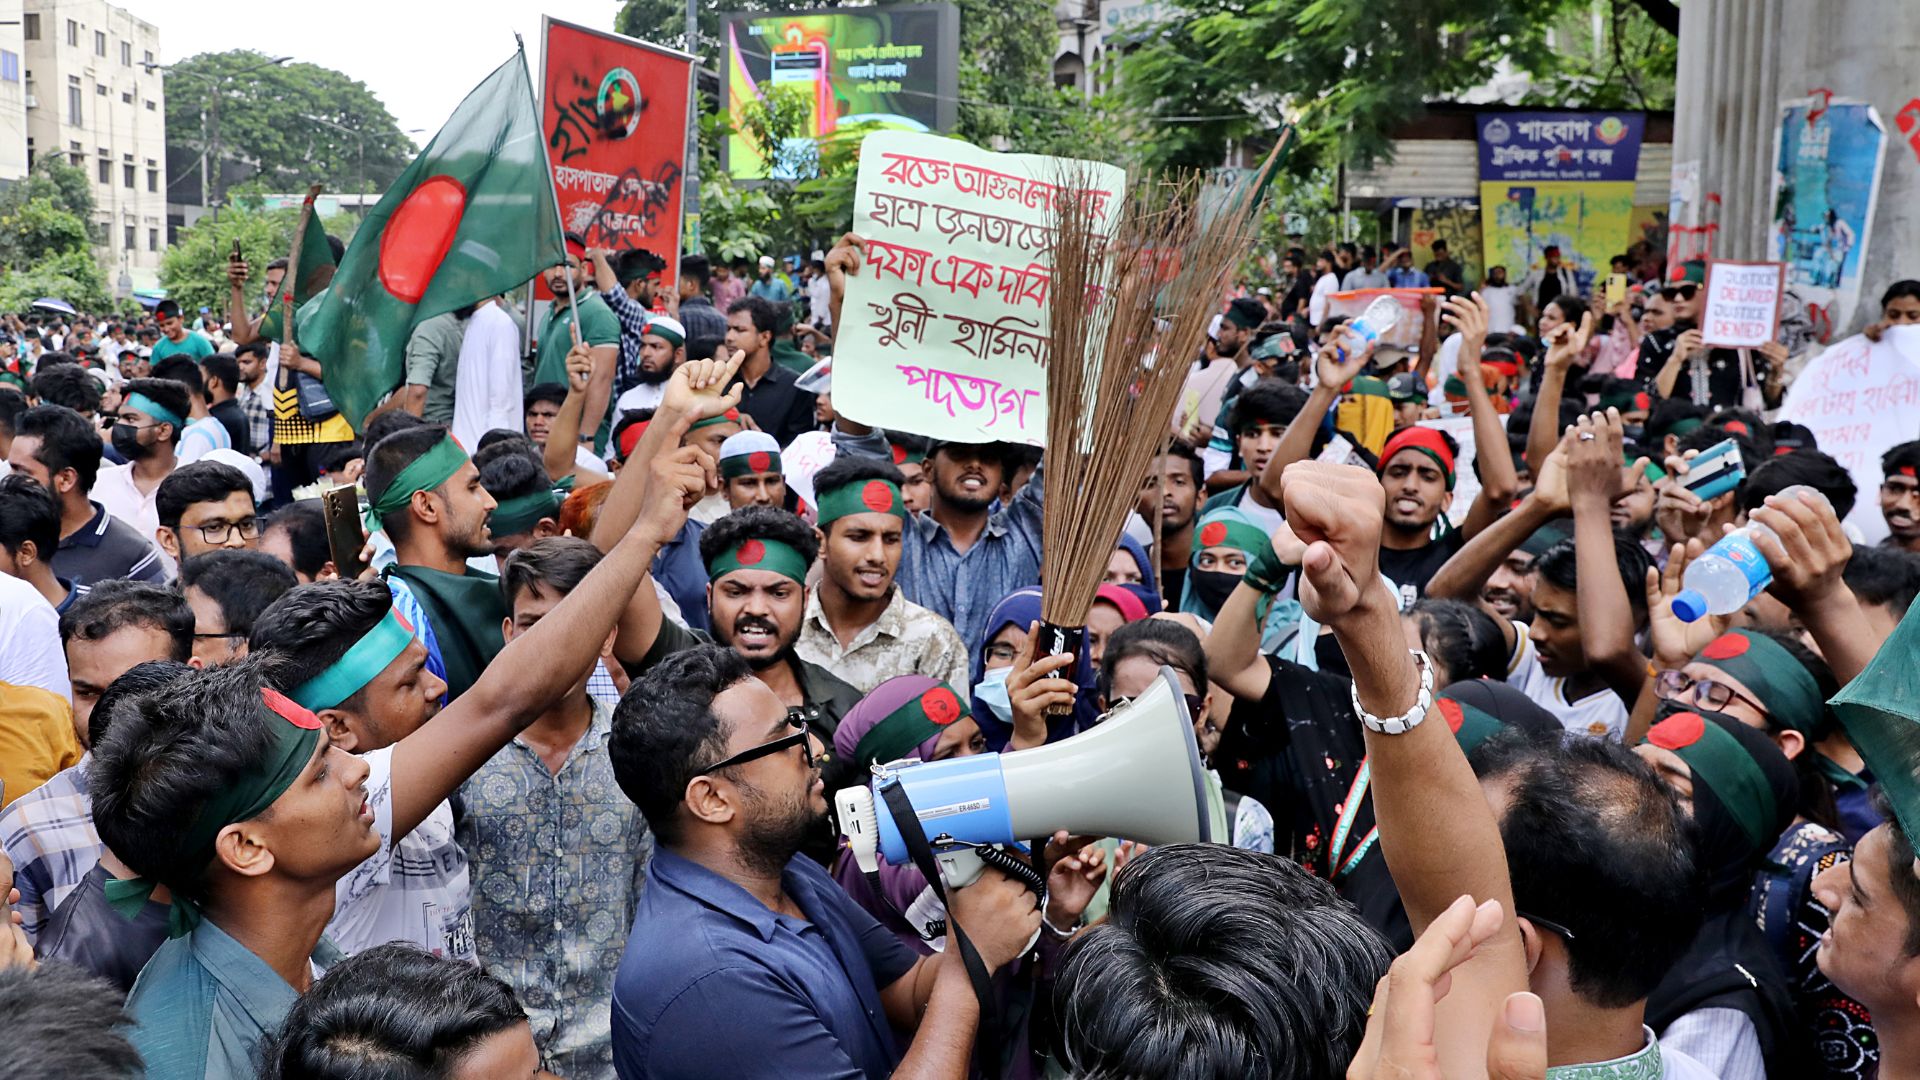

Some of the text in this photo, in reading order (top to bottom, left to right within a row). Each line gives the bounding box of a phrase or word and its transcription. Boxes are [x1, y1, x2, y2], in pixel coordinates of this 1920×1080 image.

[1516, 119, 1593, 144] শাহবাগ
[1543, 145, 1583, 167] পুিশ
[881, 153, 951, 188] রক্তে
[952, 163, 1027, 204] আগুন
[868, 191, 928, 232] ছাত্র
[932, 204, 1022, 247] জনতা
[865, 239, 933, 287] দফা
[931, 255, 994, 299] এক
[1725, 271, 1778, 287] JUSTICE
[1713, 303, 1767, 320] JUSTICE
[1713, 320, 1767, 339] DENIED
